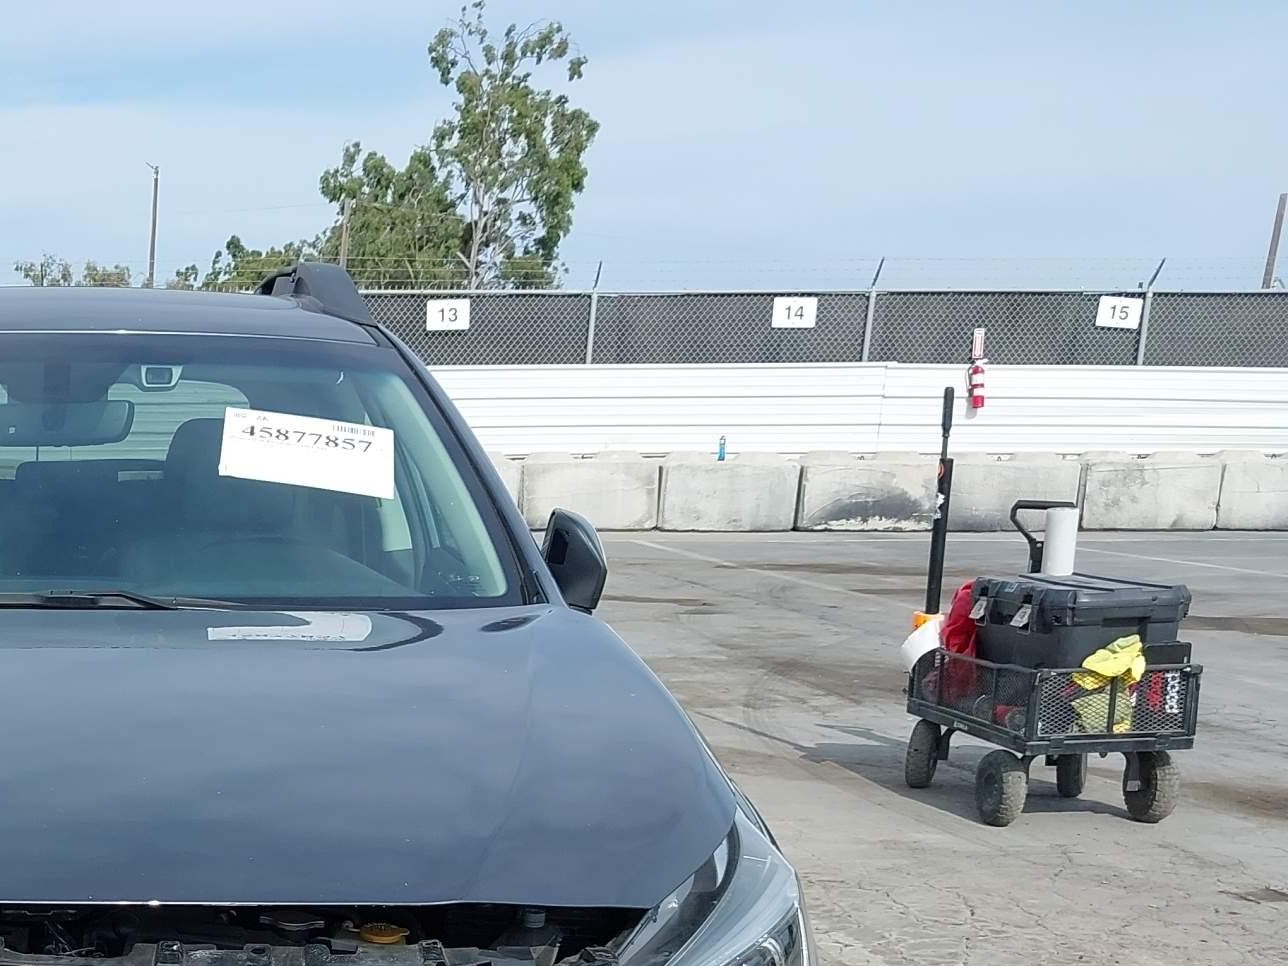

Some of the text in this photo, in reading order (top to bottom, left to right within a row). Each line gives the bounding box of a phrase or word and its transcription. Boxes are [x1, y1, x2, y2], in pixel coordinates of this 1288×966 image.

[440, 308, 459, 322] 13
[785, 306, 804, 320] 14
[1110, 305, 1129, 320] 15
[240, 424, 372, 454] 45877857
